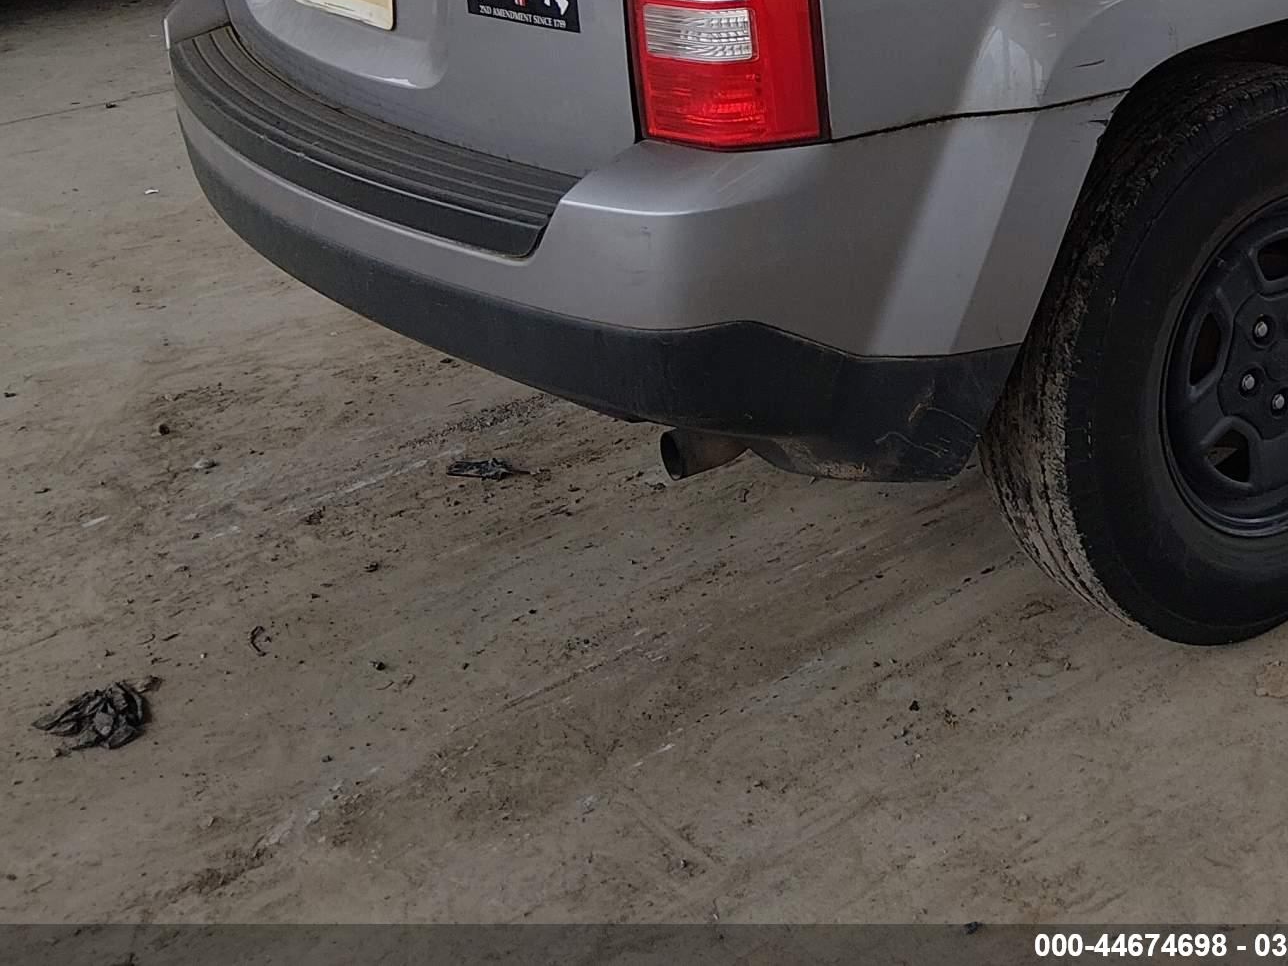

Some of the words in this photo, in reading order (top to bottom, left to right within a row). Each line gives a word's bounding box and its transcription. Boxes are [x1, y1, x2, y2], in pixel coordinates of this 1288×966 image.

[479, 5, 492, 15] 2ND
[492, 7, 532, 23] AMENDMENT
[533, 15, 552, 27] SINCE
